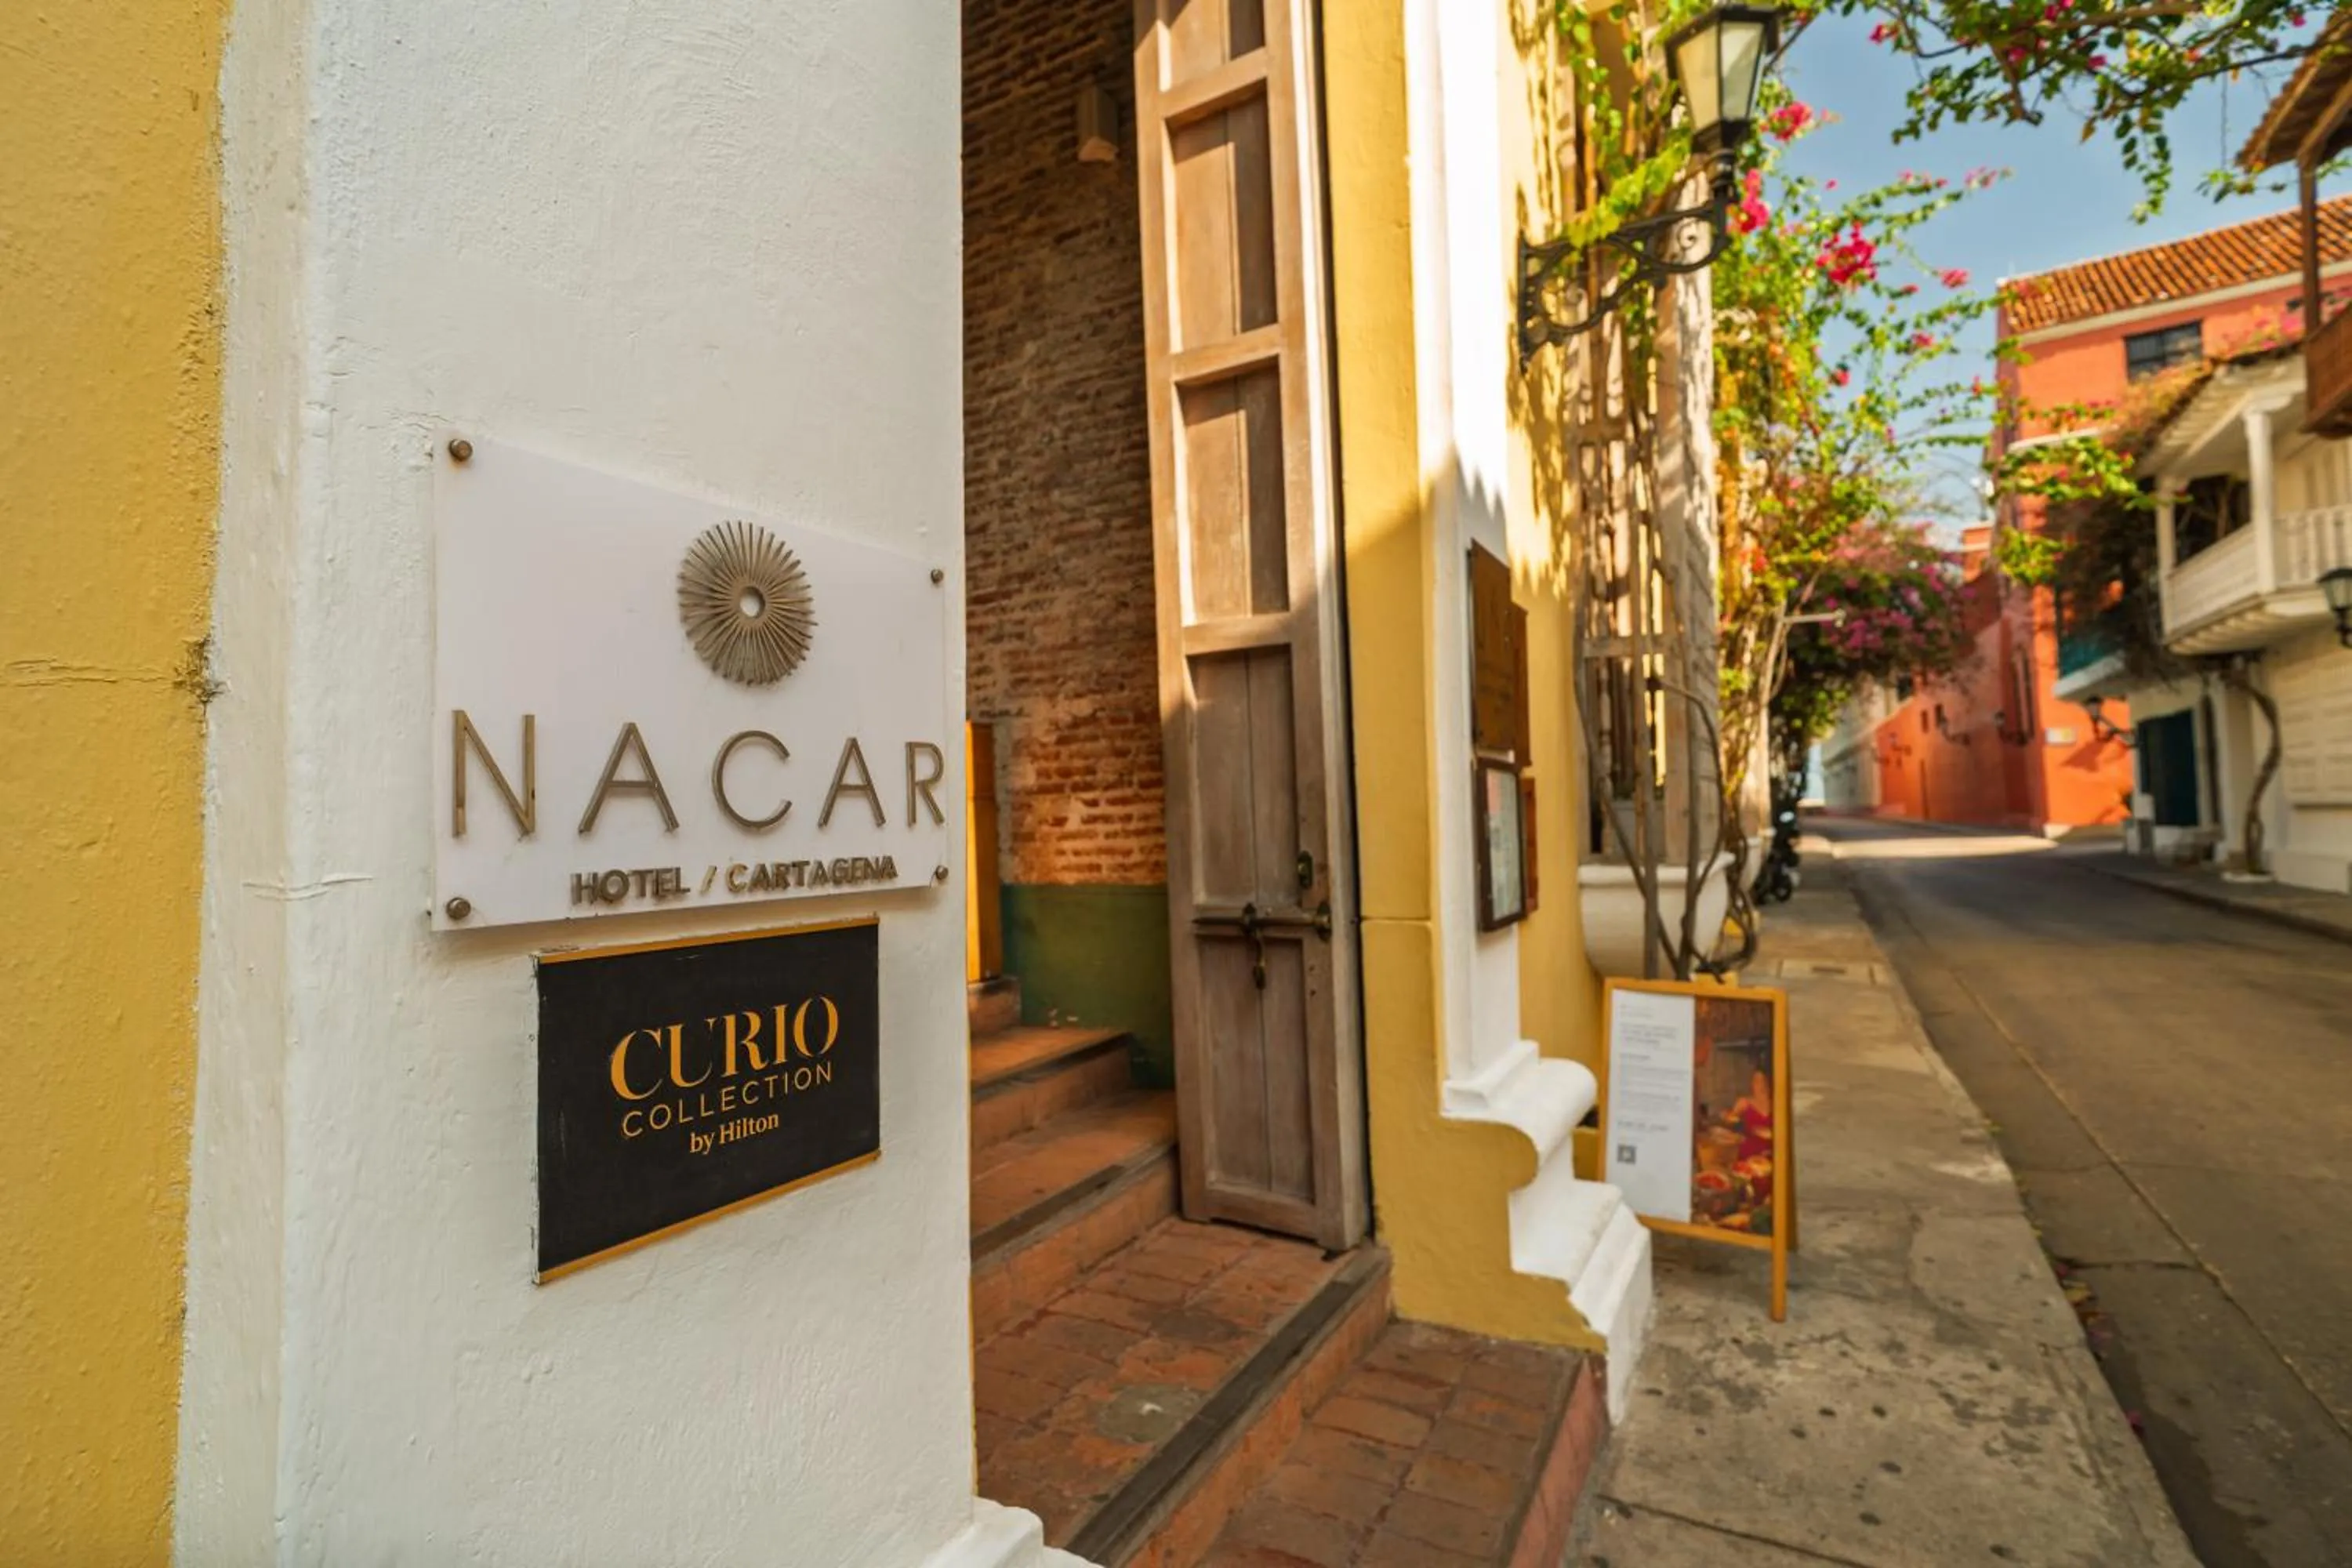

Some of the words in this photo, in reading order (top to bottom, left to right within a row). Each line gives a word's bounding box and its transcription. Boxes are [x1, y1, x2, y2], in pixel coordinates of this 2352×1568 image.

[452, 709, 944, 837] NACAR
[571, 866, 690, 904] HOTEL
[726, 855, 898, 893] CARTAGENA
[610, 996, 839, 1100] CURIO
[622, 1061, 833, 1138] COLLECTION
[689, 1131, 715, 1155] by
[719, 1113, 779, 1145] Hilton
